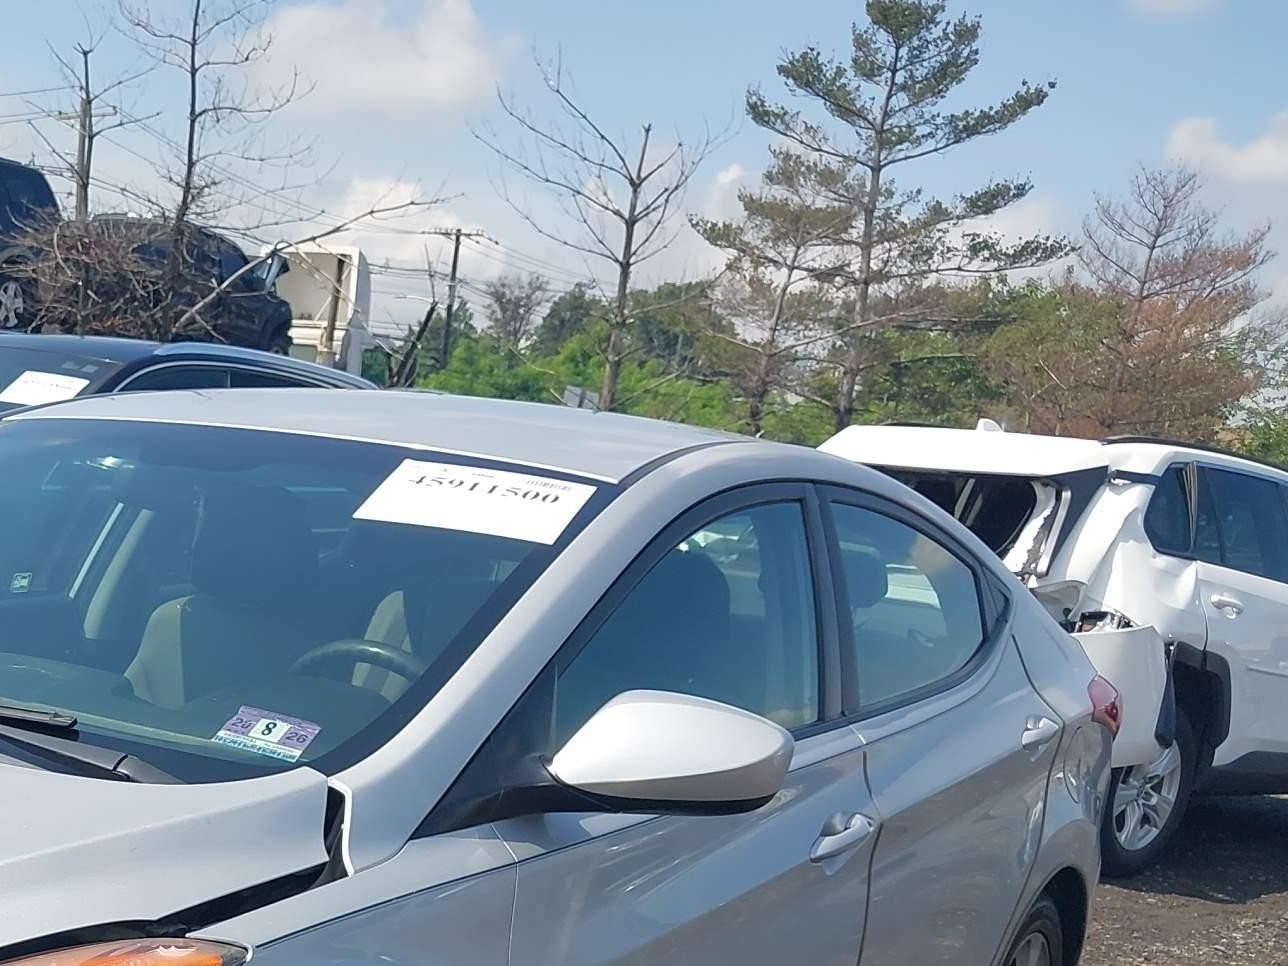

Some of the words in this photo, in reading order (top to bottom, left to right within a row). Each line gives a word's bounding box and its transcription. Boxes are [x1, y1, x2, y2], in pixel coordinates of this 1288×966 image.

[408, 475, 560, 503] 45911500
[261, 721, 278, 736] 8
[284, 731, 310, 744] 26
